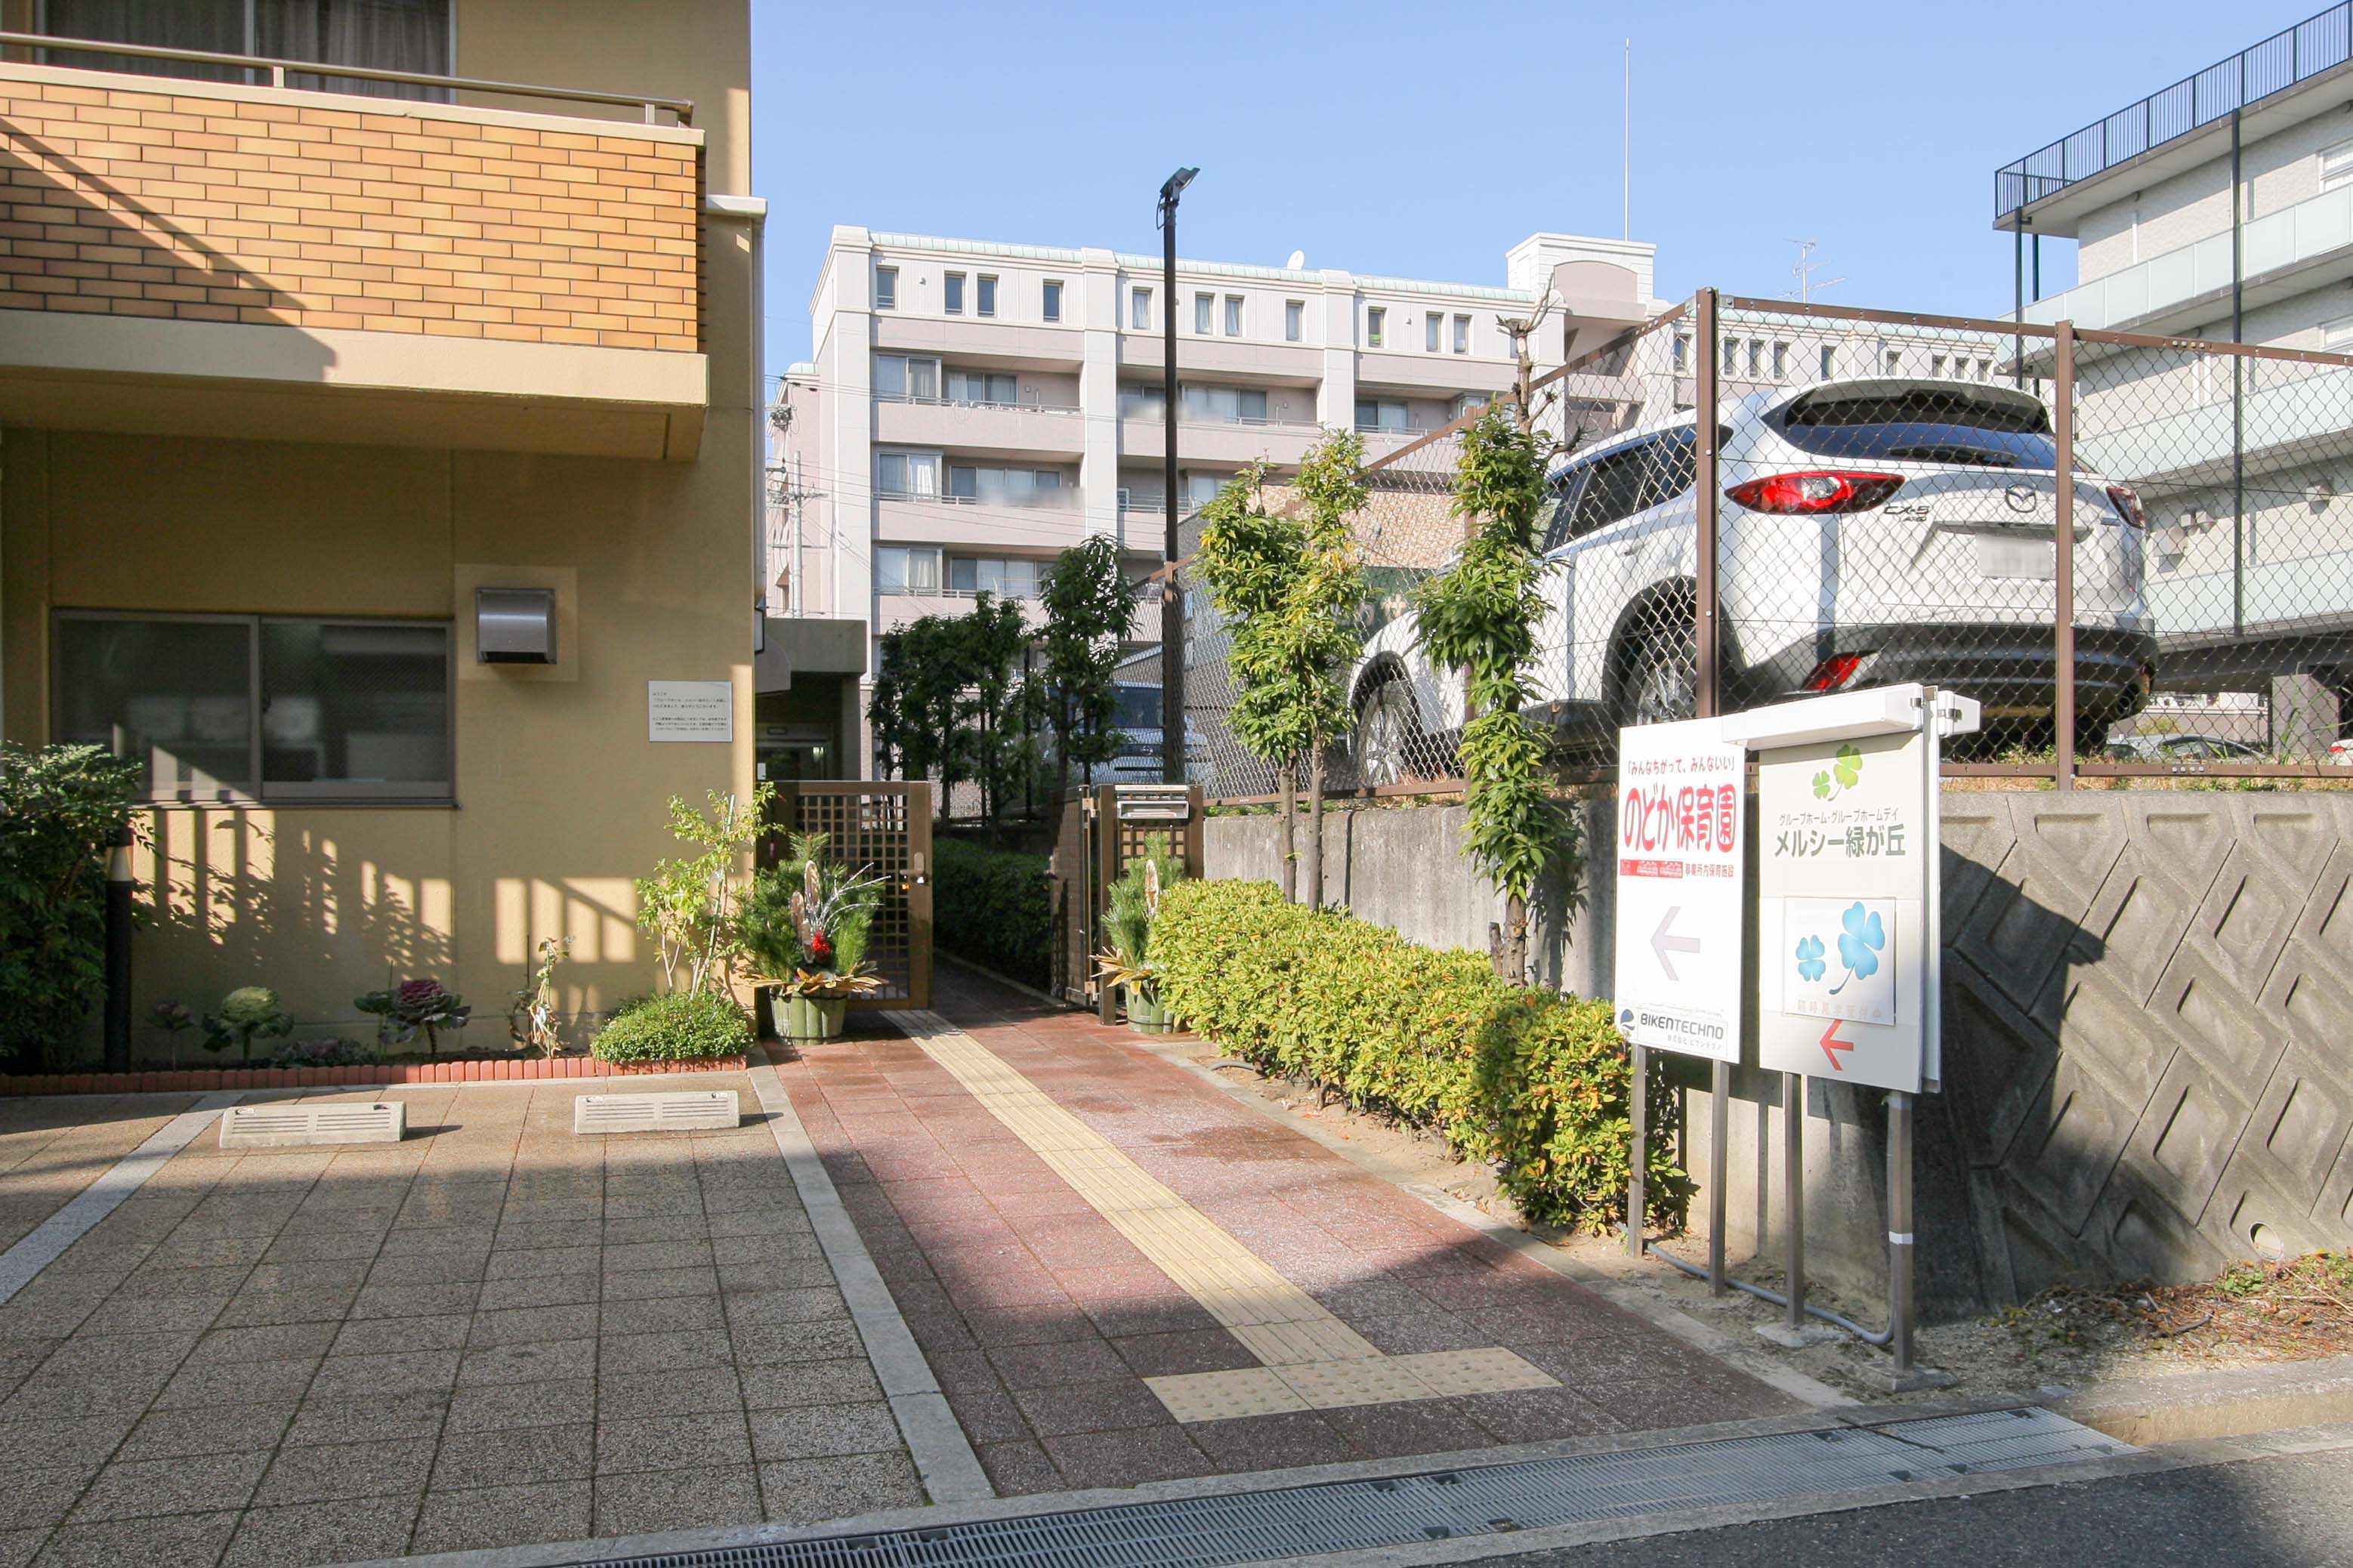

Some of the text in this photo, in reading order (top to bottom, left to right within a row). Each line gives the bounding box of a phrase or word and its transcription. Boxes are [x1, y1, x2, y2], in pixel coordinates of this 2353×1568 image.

[1883, 505, 1931, 515] CX-5
[1624, 782, 1737, 853] のどか保育園
[1774, 823, 1906, 858] メルシー緑が丘
[1641, 1013, 1724, 1040] BIKENTECHNO
